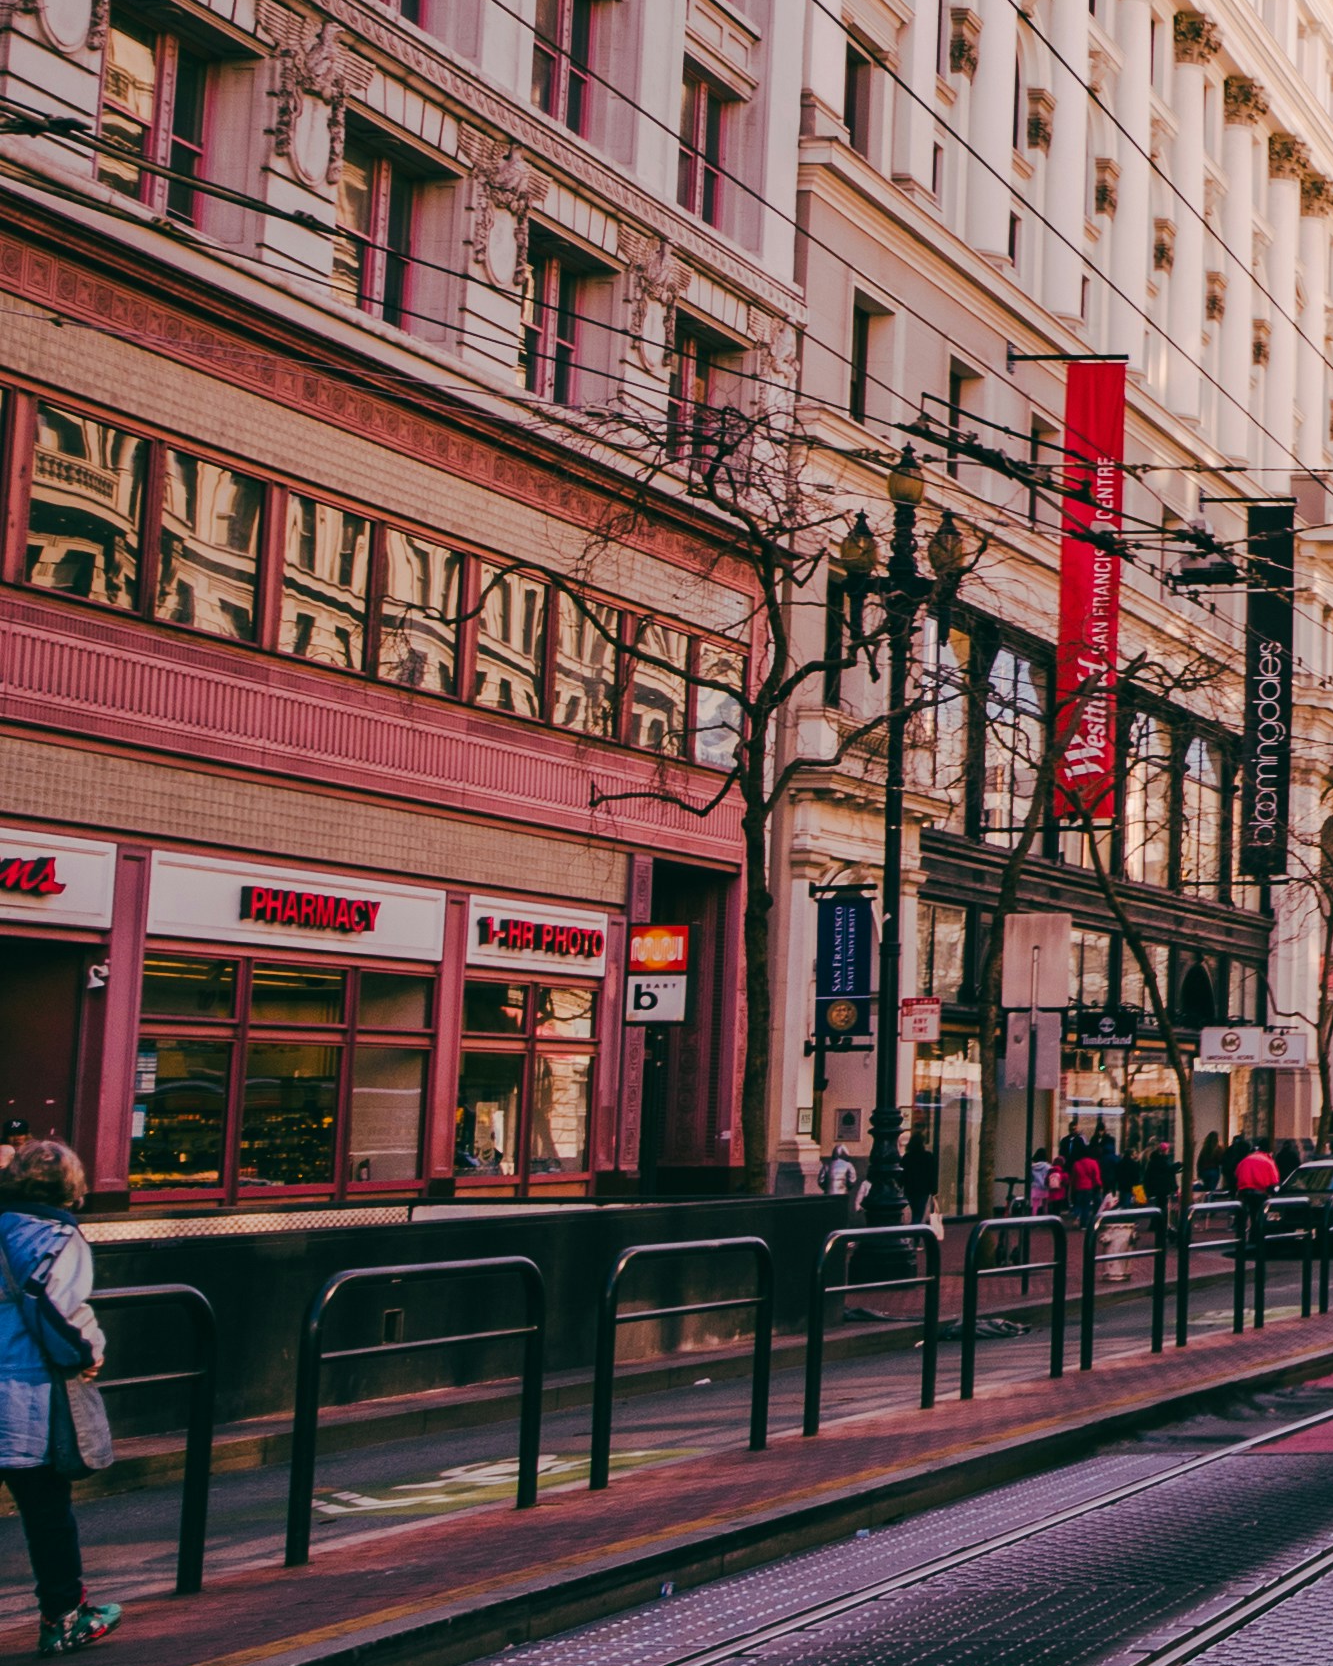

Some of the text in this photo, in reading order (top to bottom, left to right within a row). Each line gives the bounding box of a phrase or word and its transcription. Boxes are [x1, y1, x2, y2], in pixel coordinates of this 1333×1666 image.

[1095, 457, 1115, 520] CENTRE
[1091, 622, 1109, 655] SAN
[246, 886, 381, 933] PHARMACY
[480, 916, 605, 957] 1-HR PHOTO
[831, 906, 843, 992] SAN FRANCISCO
[1080, 1033, 1133, 1045] Timberland
